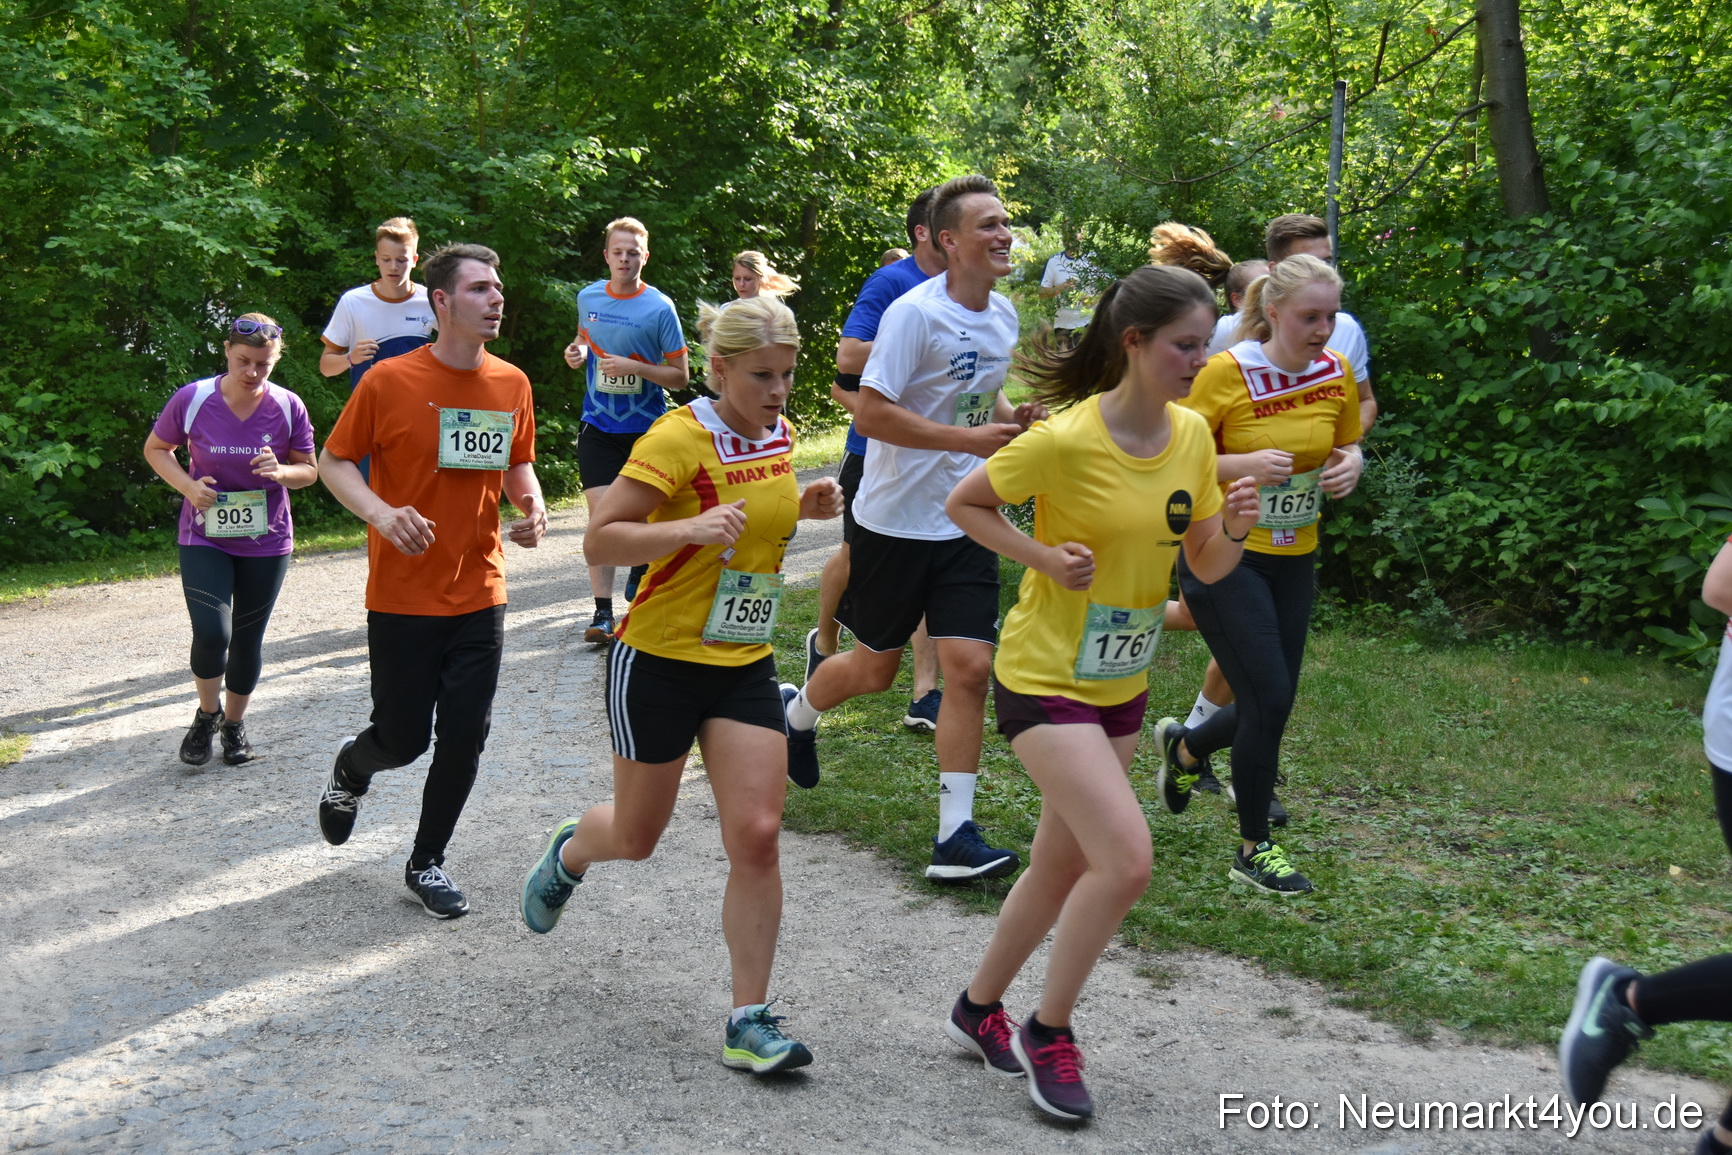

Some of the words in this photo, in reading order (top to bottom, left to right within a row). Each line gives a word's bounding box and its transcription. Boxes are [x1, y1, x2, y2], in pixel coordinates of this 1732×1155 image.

[966, 410, 989, 428] 348
[1253, 397, 1298, 419] MAX
[210, 446, 227, 454] WIR
[229, 446, 252, 455] SIND
[450, 430, 503, 454] 1802
[725, 464, 768, 486] MAX
[1266, 489, 1316, 515] 1675
[216, 507, 253, 525] 903
[724, 596, 772, 624] 1589
[1095, 627, 1157, 660] 1767
